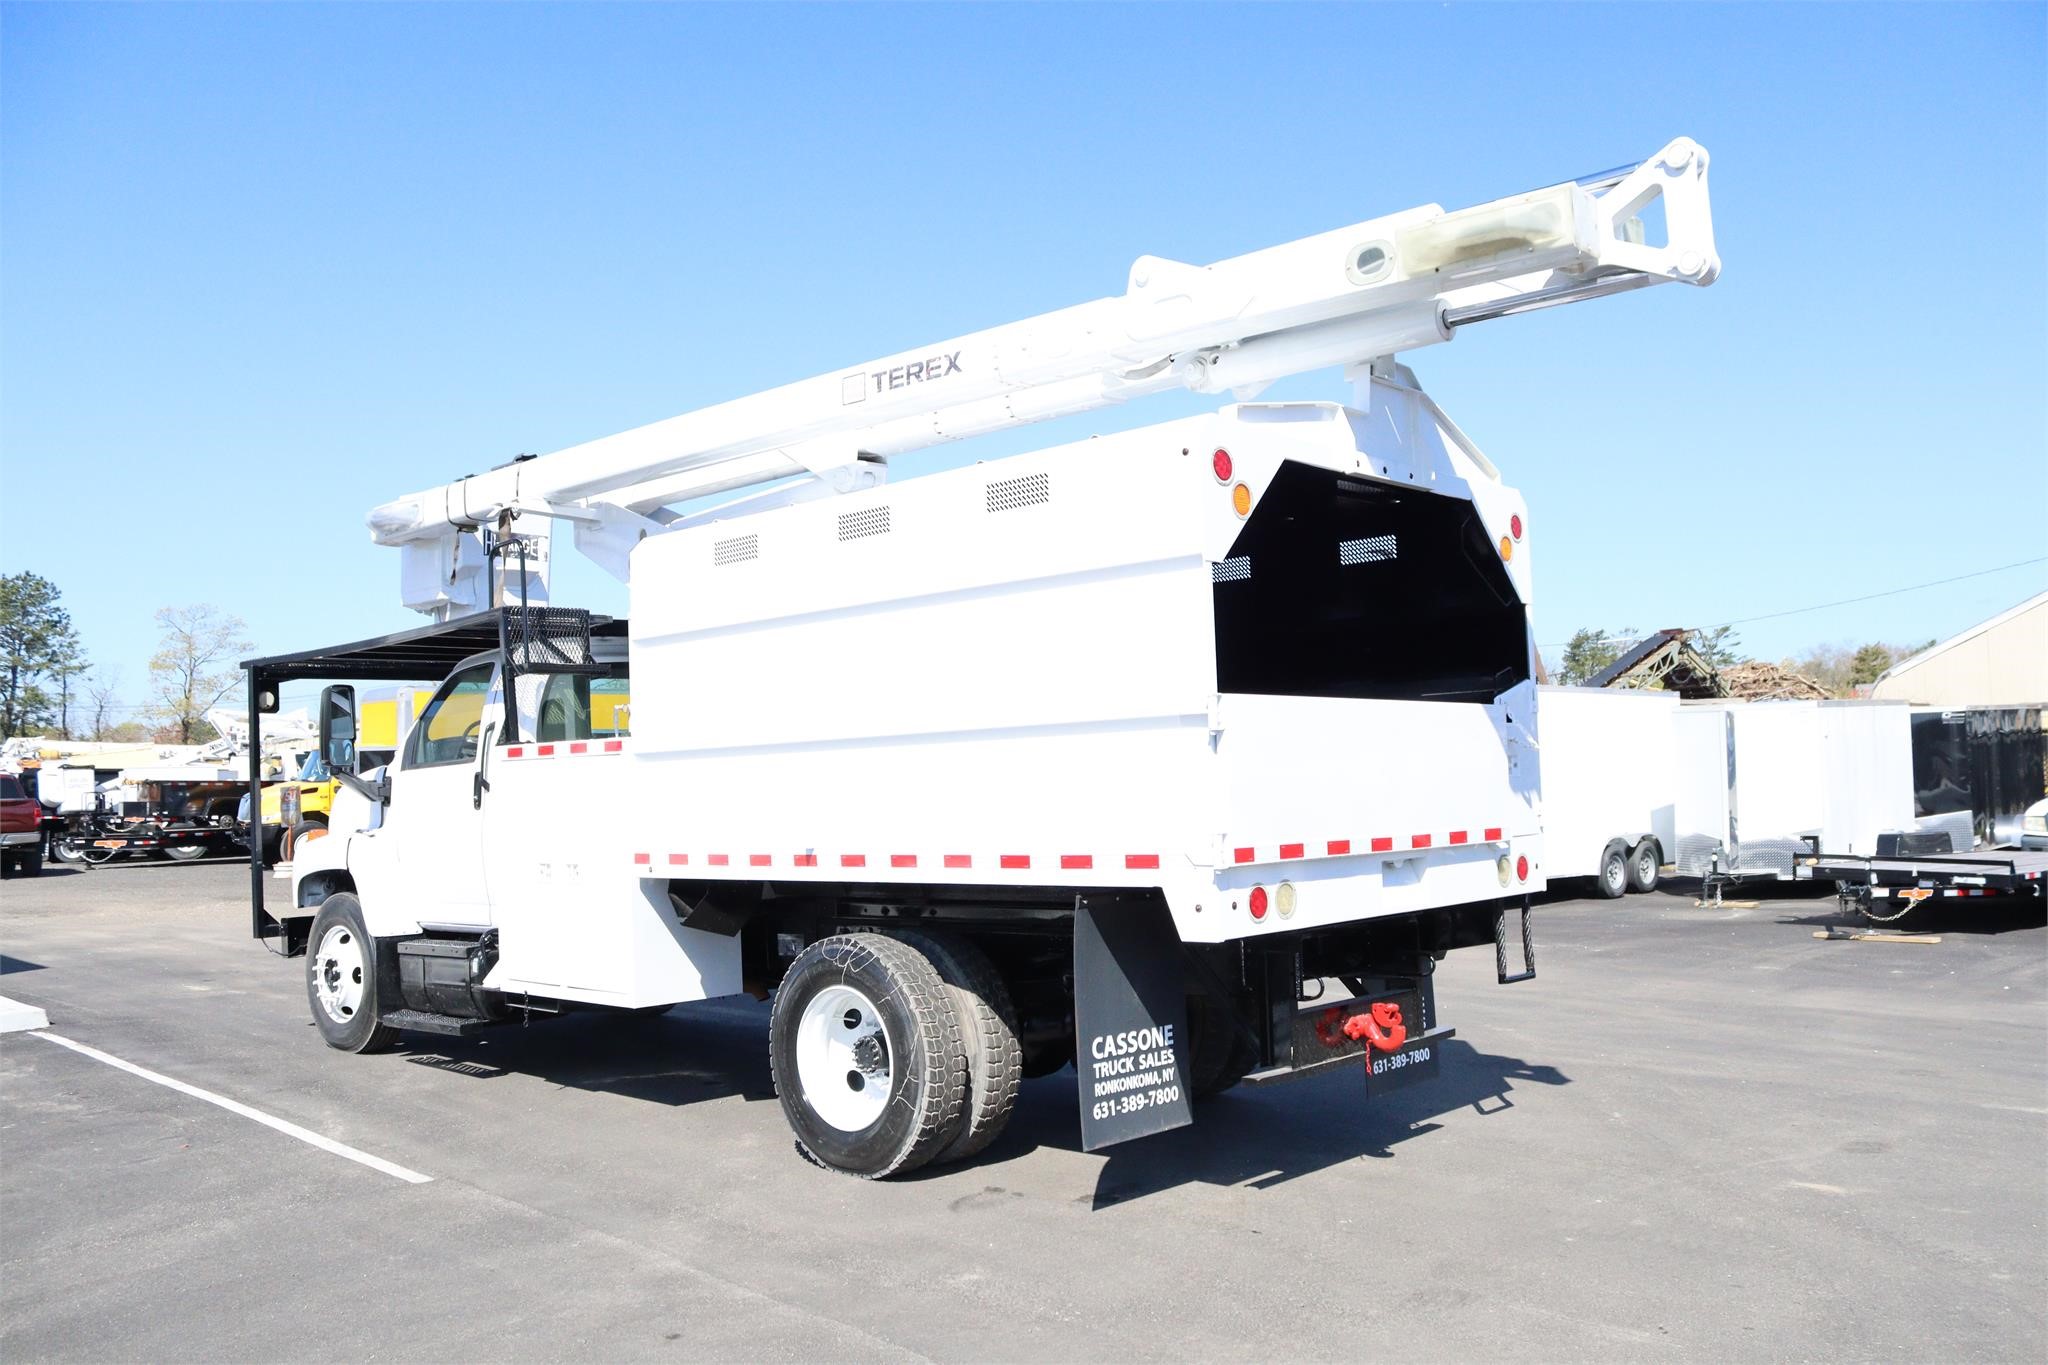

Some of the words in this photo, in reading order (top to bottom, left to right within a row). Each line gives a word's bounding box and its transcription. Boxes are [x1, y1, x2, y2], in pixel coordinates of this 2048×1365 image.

[872, 351, 962, 393] TEREX
[1092, 1024, 1174, 1059] CASSONE
[1093, 1056, 1135, 1078] TRUCK
[1139, 1049, 1175, 1070] SALES
[1373, 1047, 1430, 1075] 631-389-7800
[1094, 1071, 1161, 1097] RONKONKOMA,
[1162, 1067, 1175, 1082] NY
[1093, 1085, 1179, 1120] 631-389-7800
